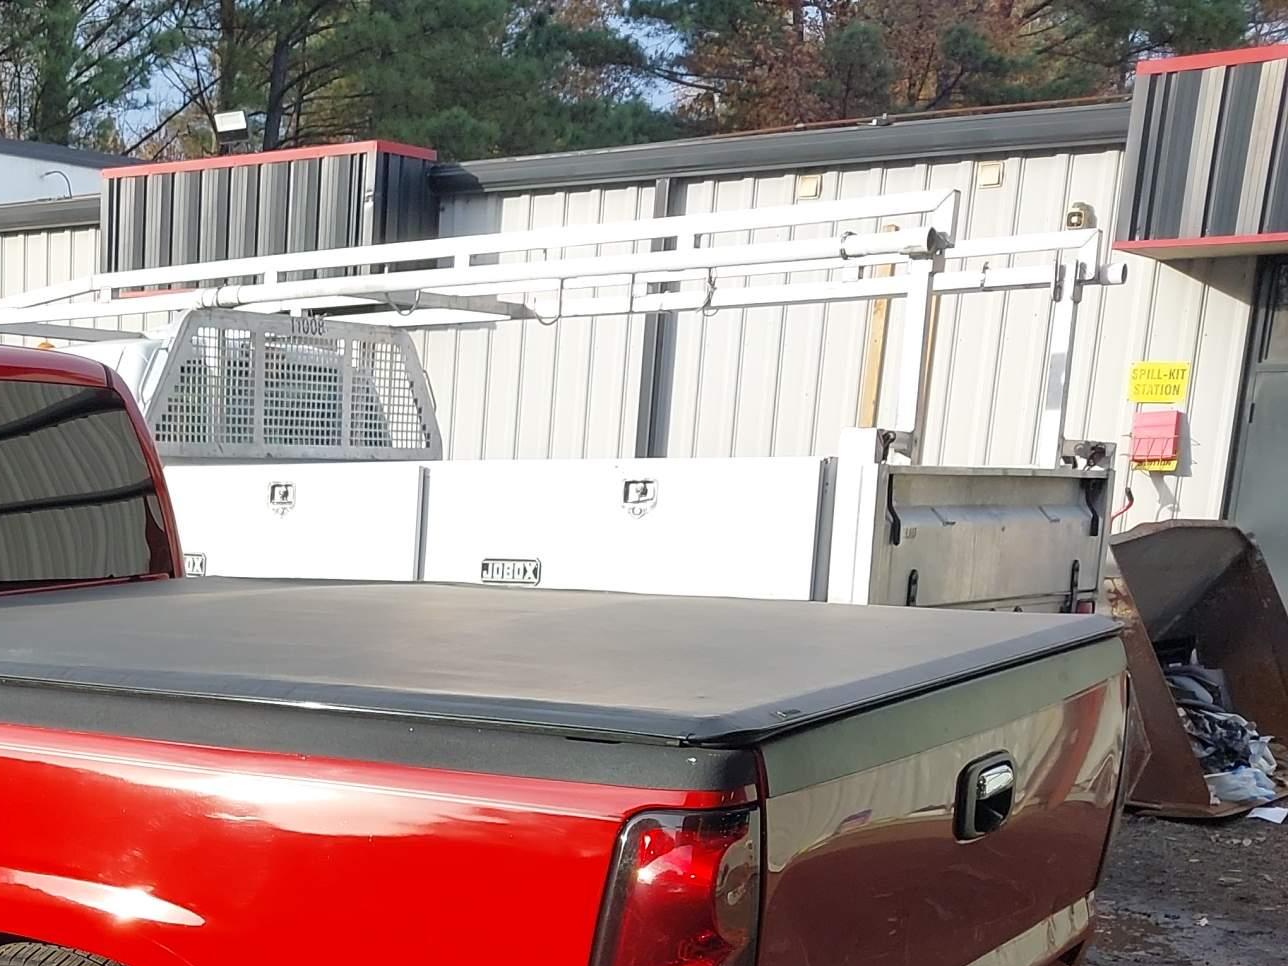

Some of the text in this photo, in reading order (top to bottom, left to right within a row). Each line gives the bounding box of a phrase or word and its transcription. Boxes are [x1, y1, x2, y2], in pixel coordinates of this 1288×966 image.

[1131, 368, 1187, 381] SPILL-KIT
[1133, 383, 1182, 396] STATION
[481, 562, 539, 580] JOBOX
